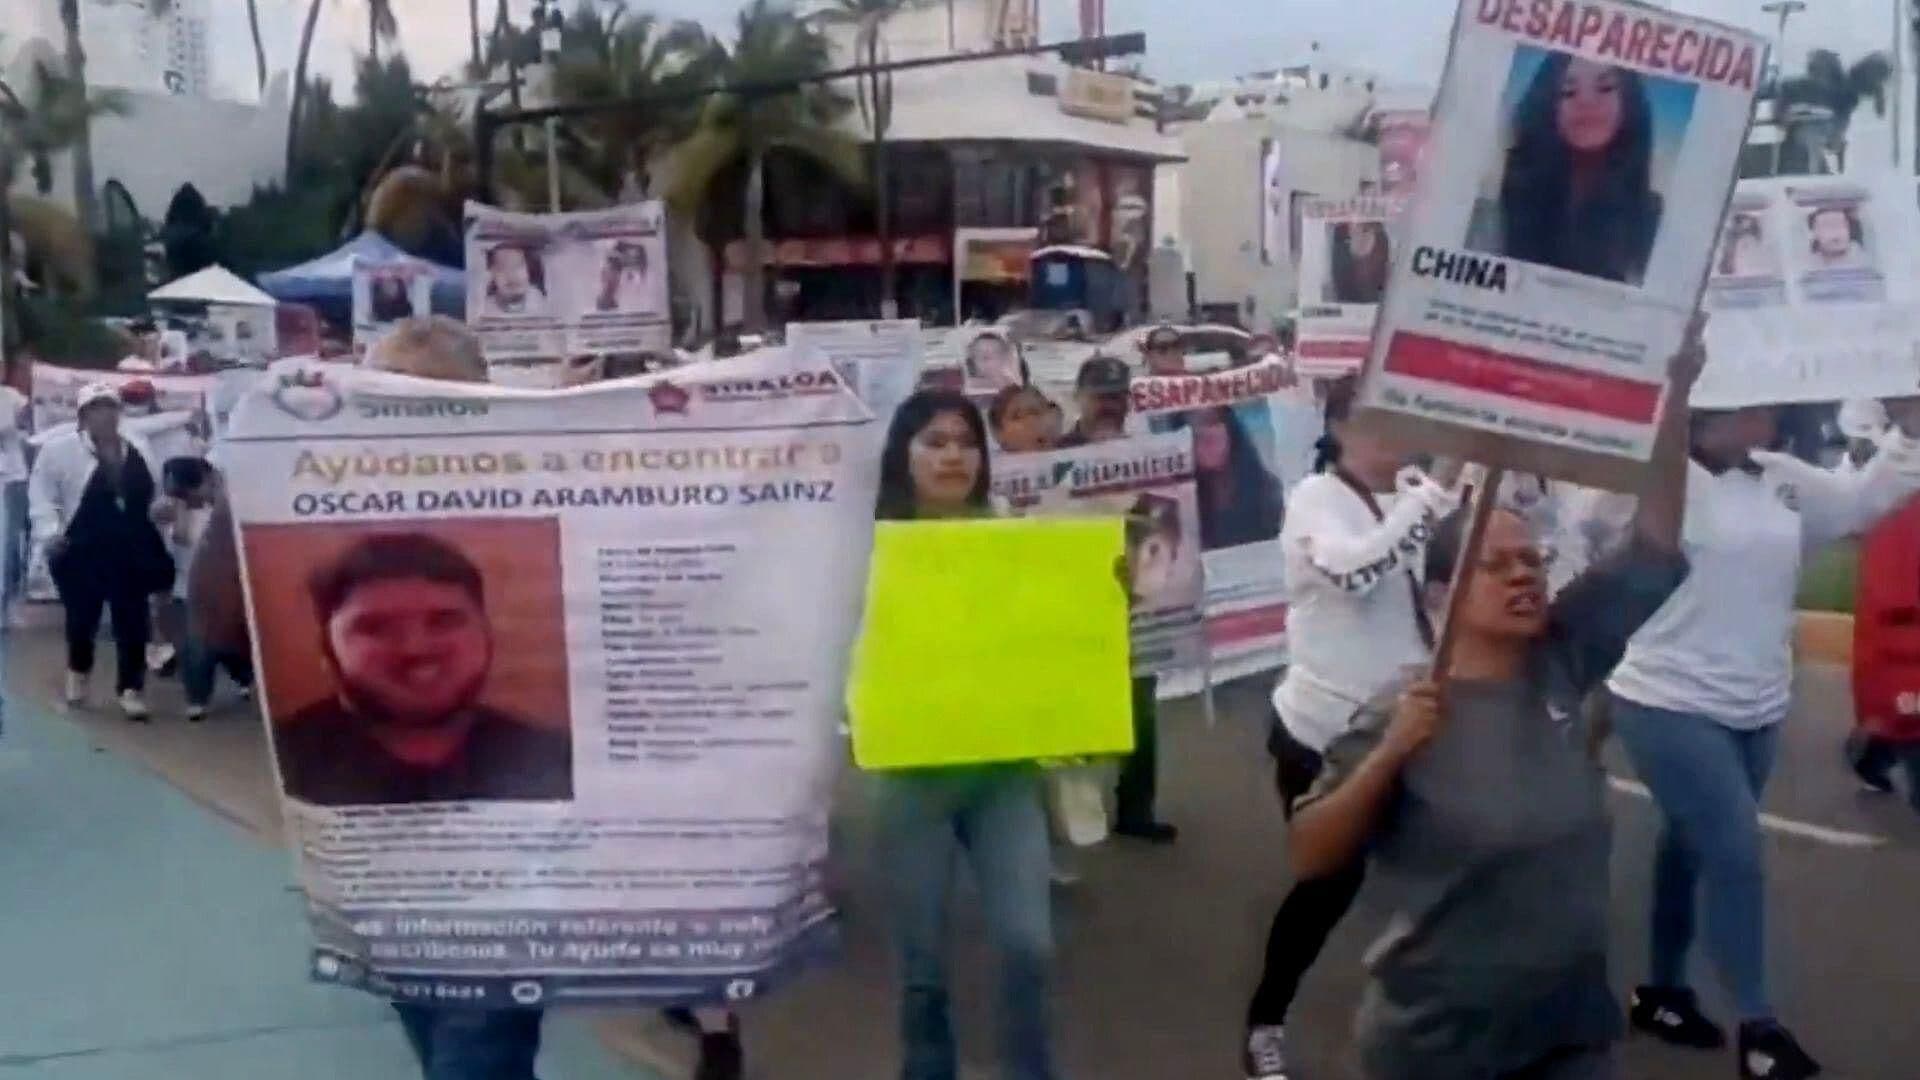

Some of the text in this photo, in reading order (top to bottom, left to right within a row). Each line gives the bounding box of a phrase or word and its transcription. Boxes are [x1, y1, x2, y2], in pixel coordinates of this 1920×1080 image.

[1476, 0, 1758, 91] DESAPARECIDA
[1411, 245, 1508, 294] CHINA
[1129, 357, 1298, 413] ESAPARECIDA
[292, 448, 526, 485] Ayúdanos
[541, 450, 567, 473] a
[582, 442, 806, 473] encontrar
[292, 480, 836, 516] OSCAR DAVID ARAMBURO SAINZ
[396, 916, 549, 938] información
